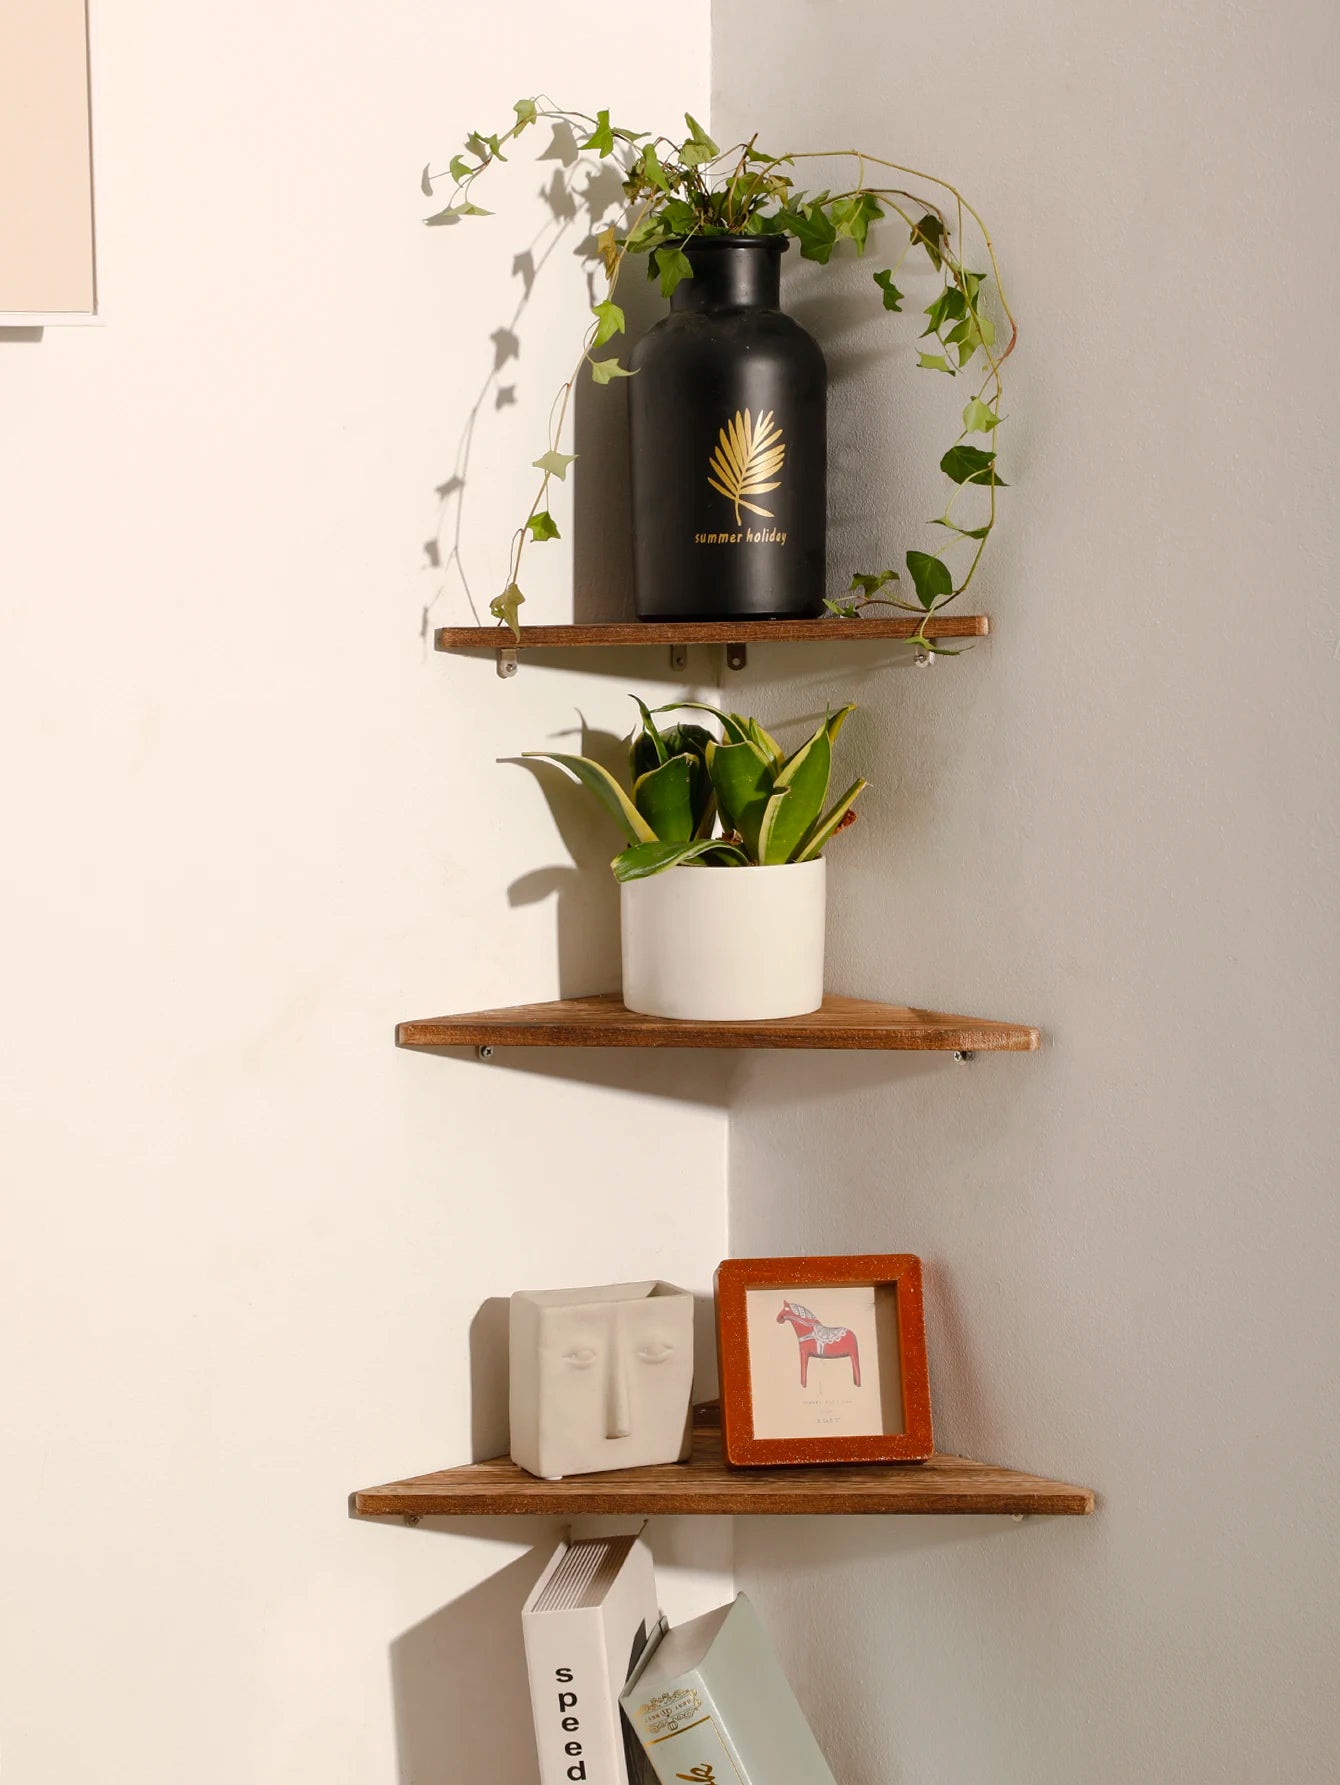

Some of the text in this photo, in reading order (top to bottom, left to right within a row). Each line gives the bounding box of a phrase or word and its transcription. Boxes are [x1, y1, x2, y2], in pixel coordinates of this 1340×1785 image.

[694, 527, 787, 546] summer holiday
[555, 1667, 587, 1781] speed
